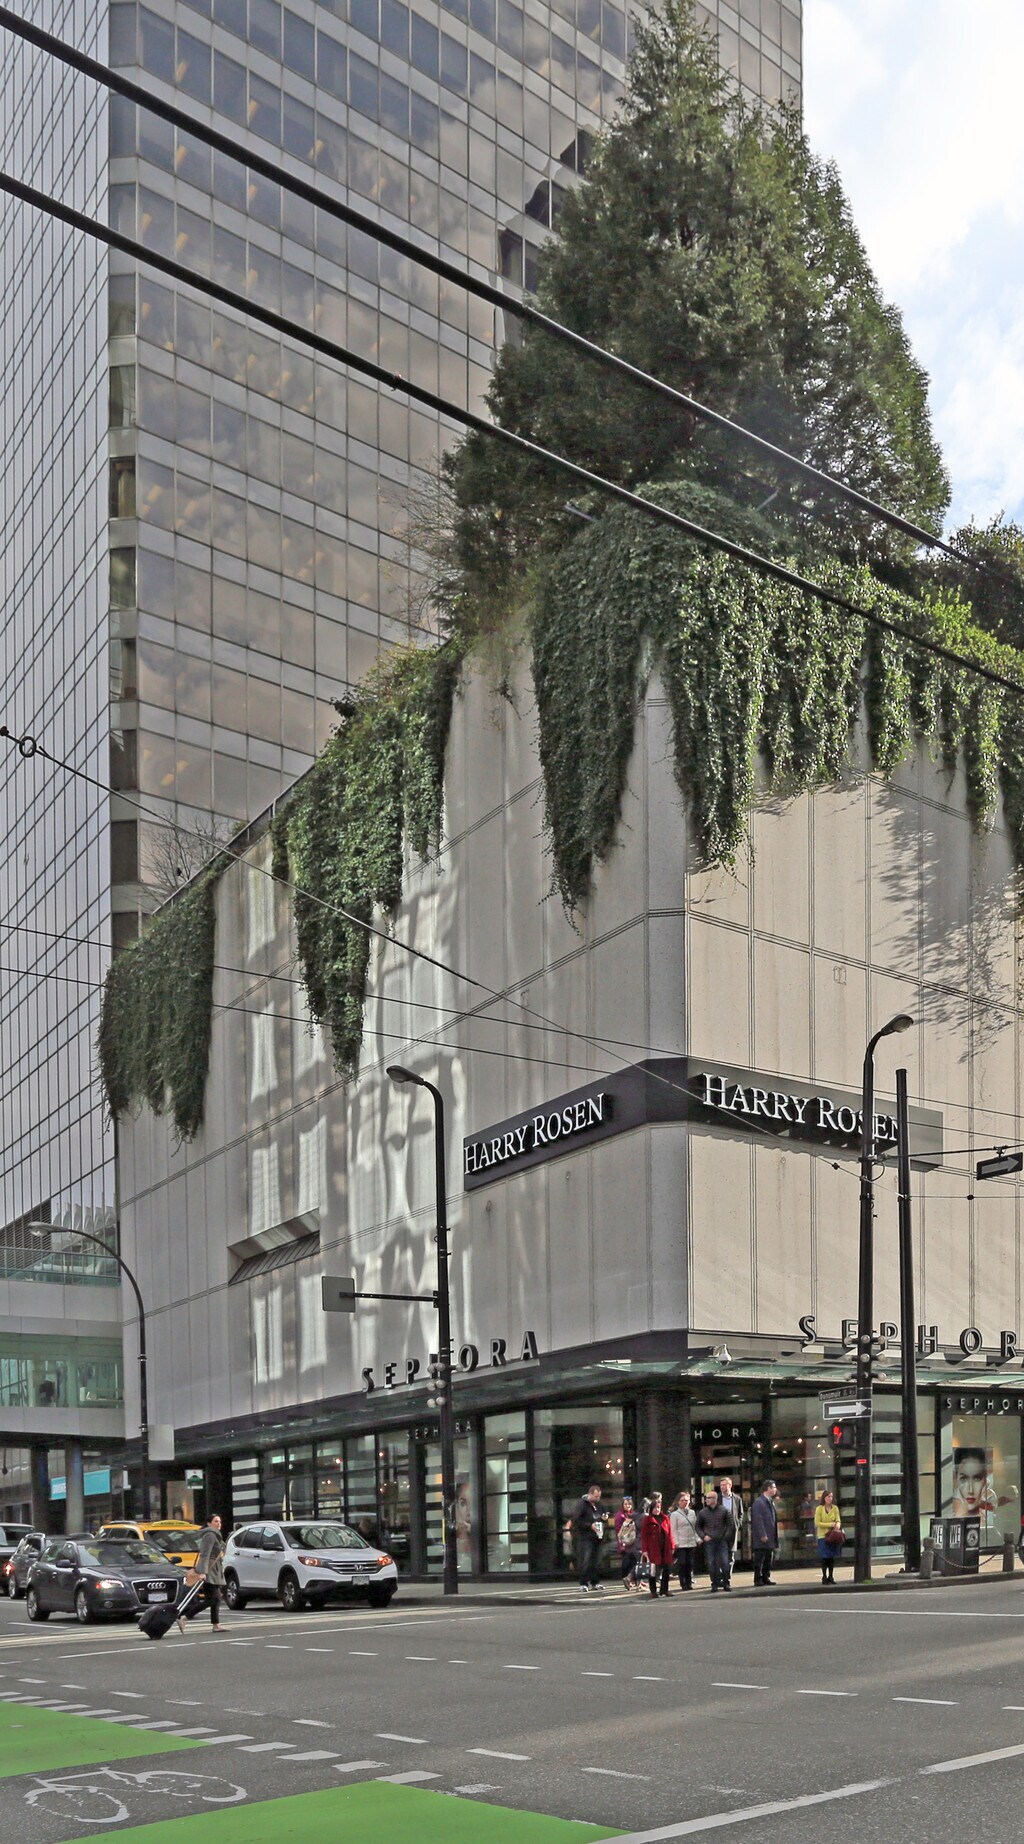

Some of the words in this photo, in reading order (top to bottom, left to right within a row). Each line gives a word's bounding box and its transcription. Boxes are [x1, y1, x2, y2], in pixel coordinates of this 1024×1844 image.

[701, 1073, 806, 1124] HARRY
[463, 1124, 528, 1174] HARRY
[532, 1093, 604, 1148] ROSEN
[361, 1330, 540, 1393] SEPHORA
[405, 1420, 472, 1441] SEPHRA
[693, 1427, 757, 1440] HORA
